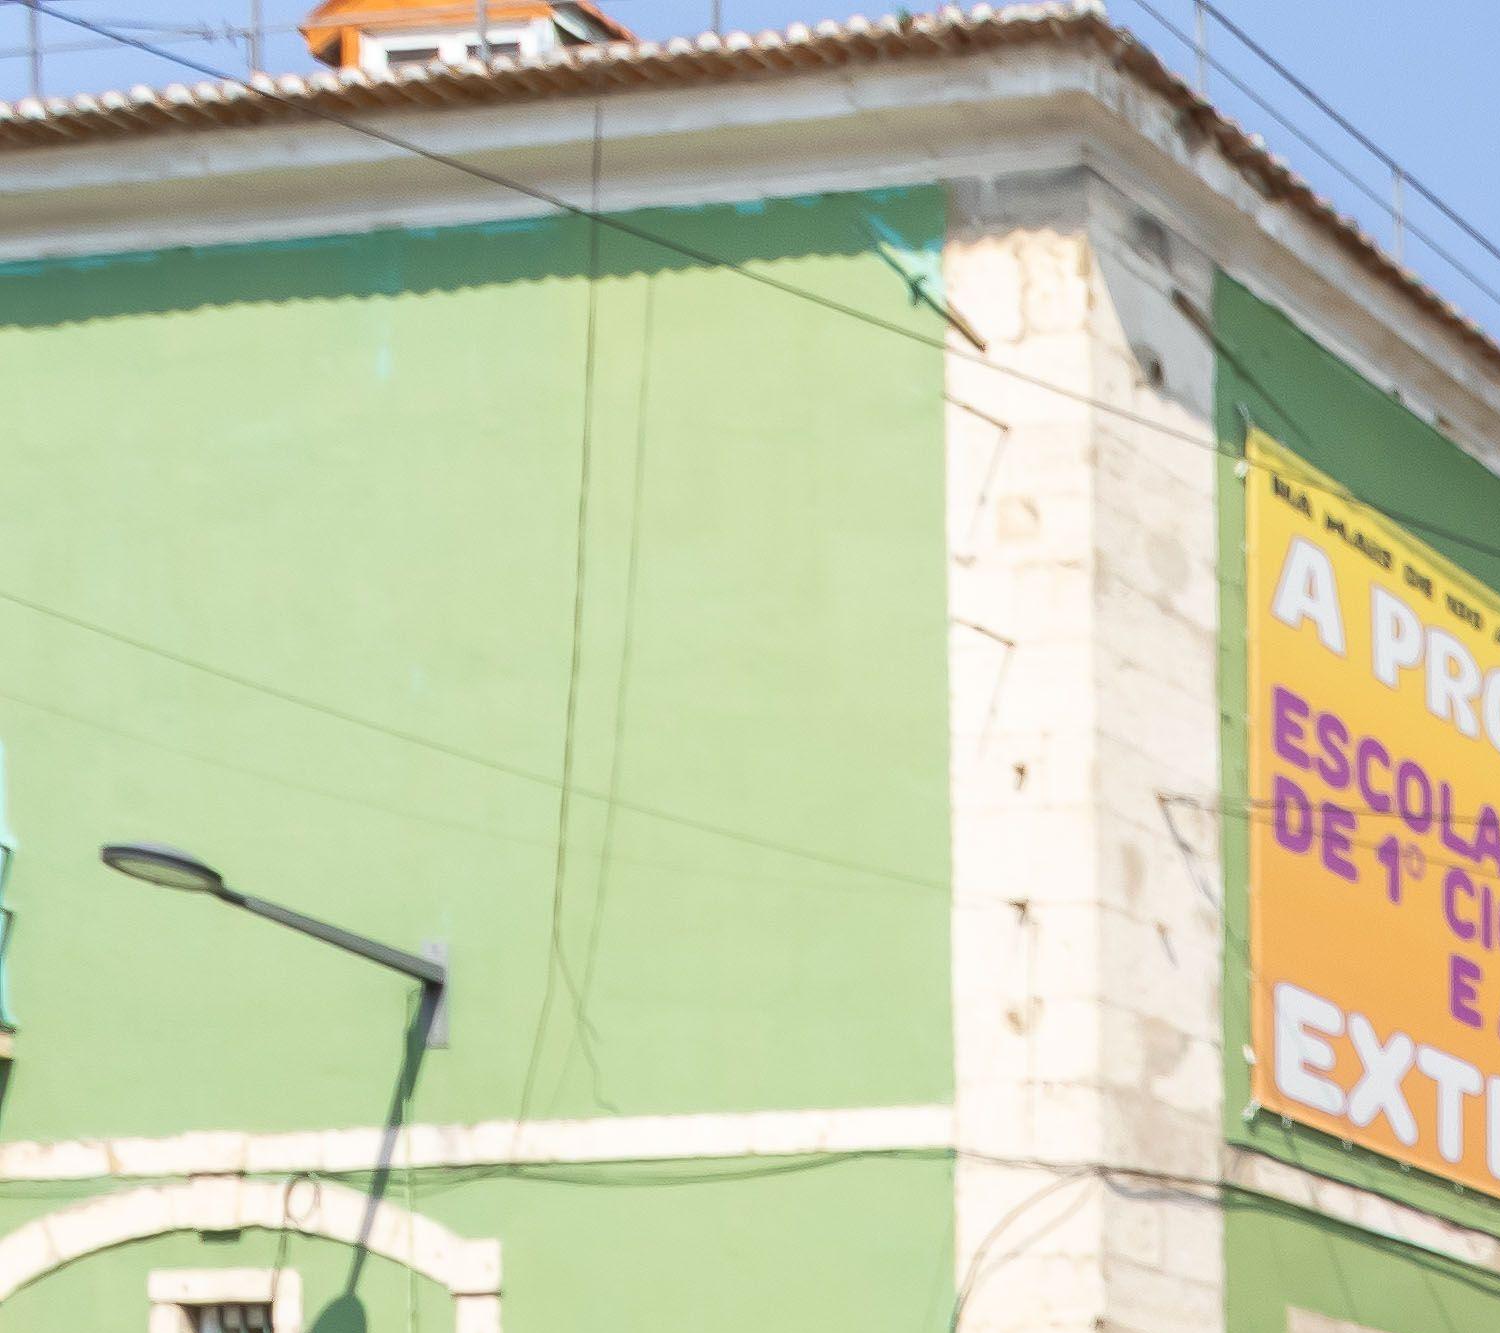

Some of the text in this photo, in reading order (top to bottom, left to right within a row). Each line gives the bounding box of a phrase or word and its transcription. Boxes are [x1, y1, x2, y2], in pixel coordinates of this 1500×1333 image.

[1272, 534, 1346, 656] A
[1271, 771, 1358, 881] DE
[1448, 953, 1483, 1029] E
